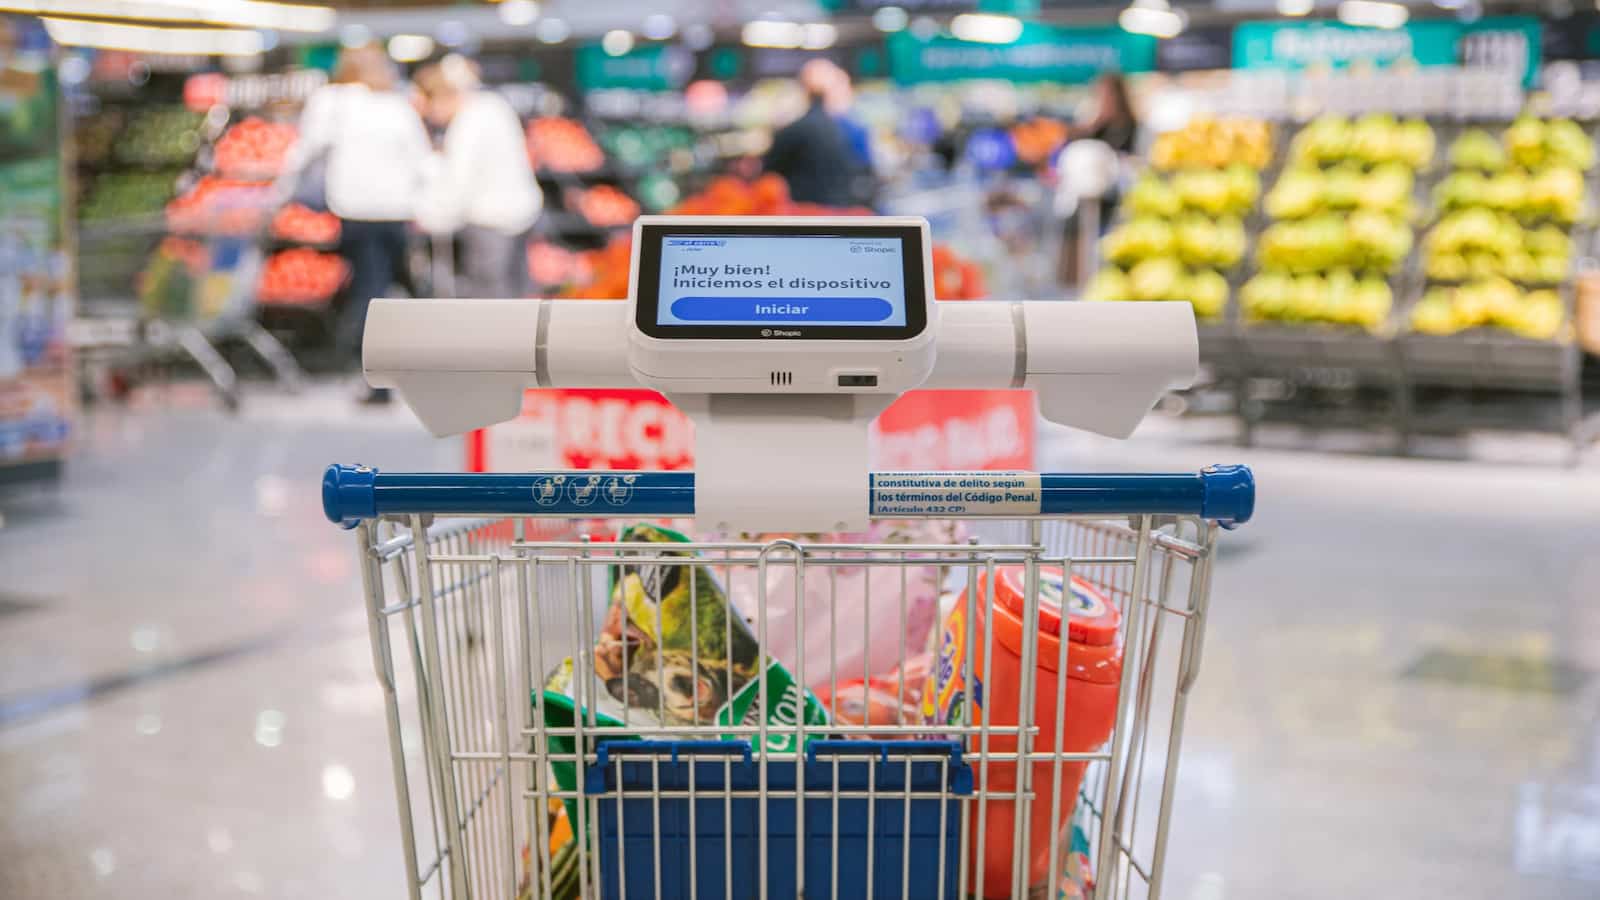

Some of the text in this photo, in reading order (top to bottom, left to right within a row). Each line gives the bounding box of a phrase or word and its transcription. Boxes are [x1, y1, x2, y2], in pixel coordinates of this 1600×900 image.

[674, 264, 770, 277] ¡Muy bien!
[673, 277, 891, 291] Iniciemos el dispositivo
[755, 303, 809, 315] Iniciar
[773, 328, 802, 338] Shopic
[878, 479, 1025, 489] constitutiva de delito según
[878, 492, 1038, 504] los términos del Código Penal.
[926, 505, 946, 513] 432
